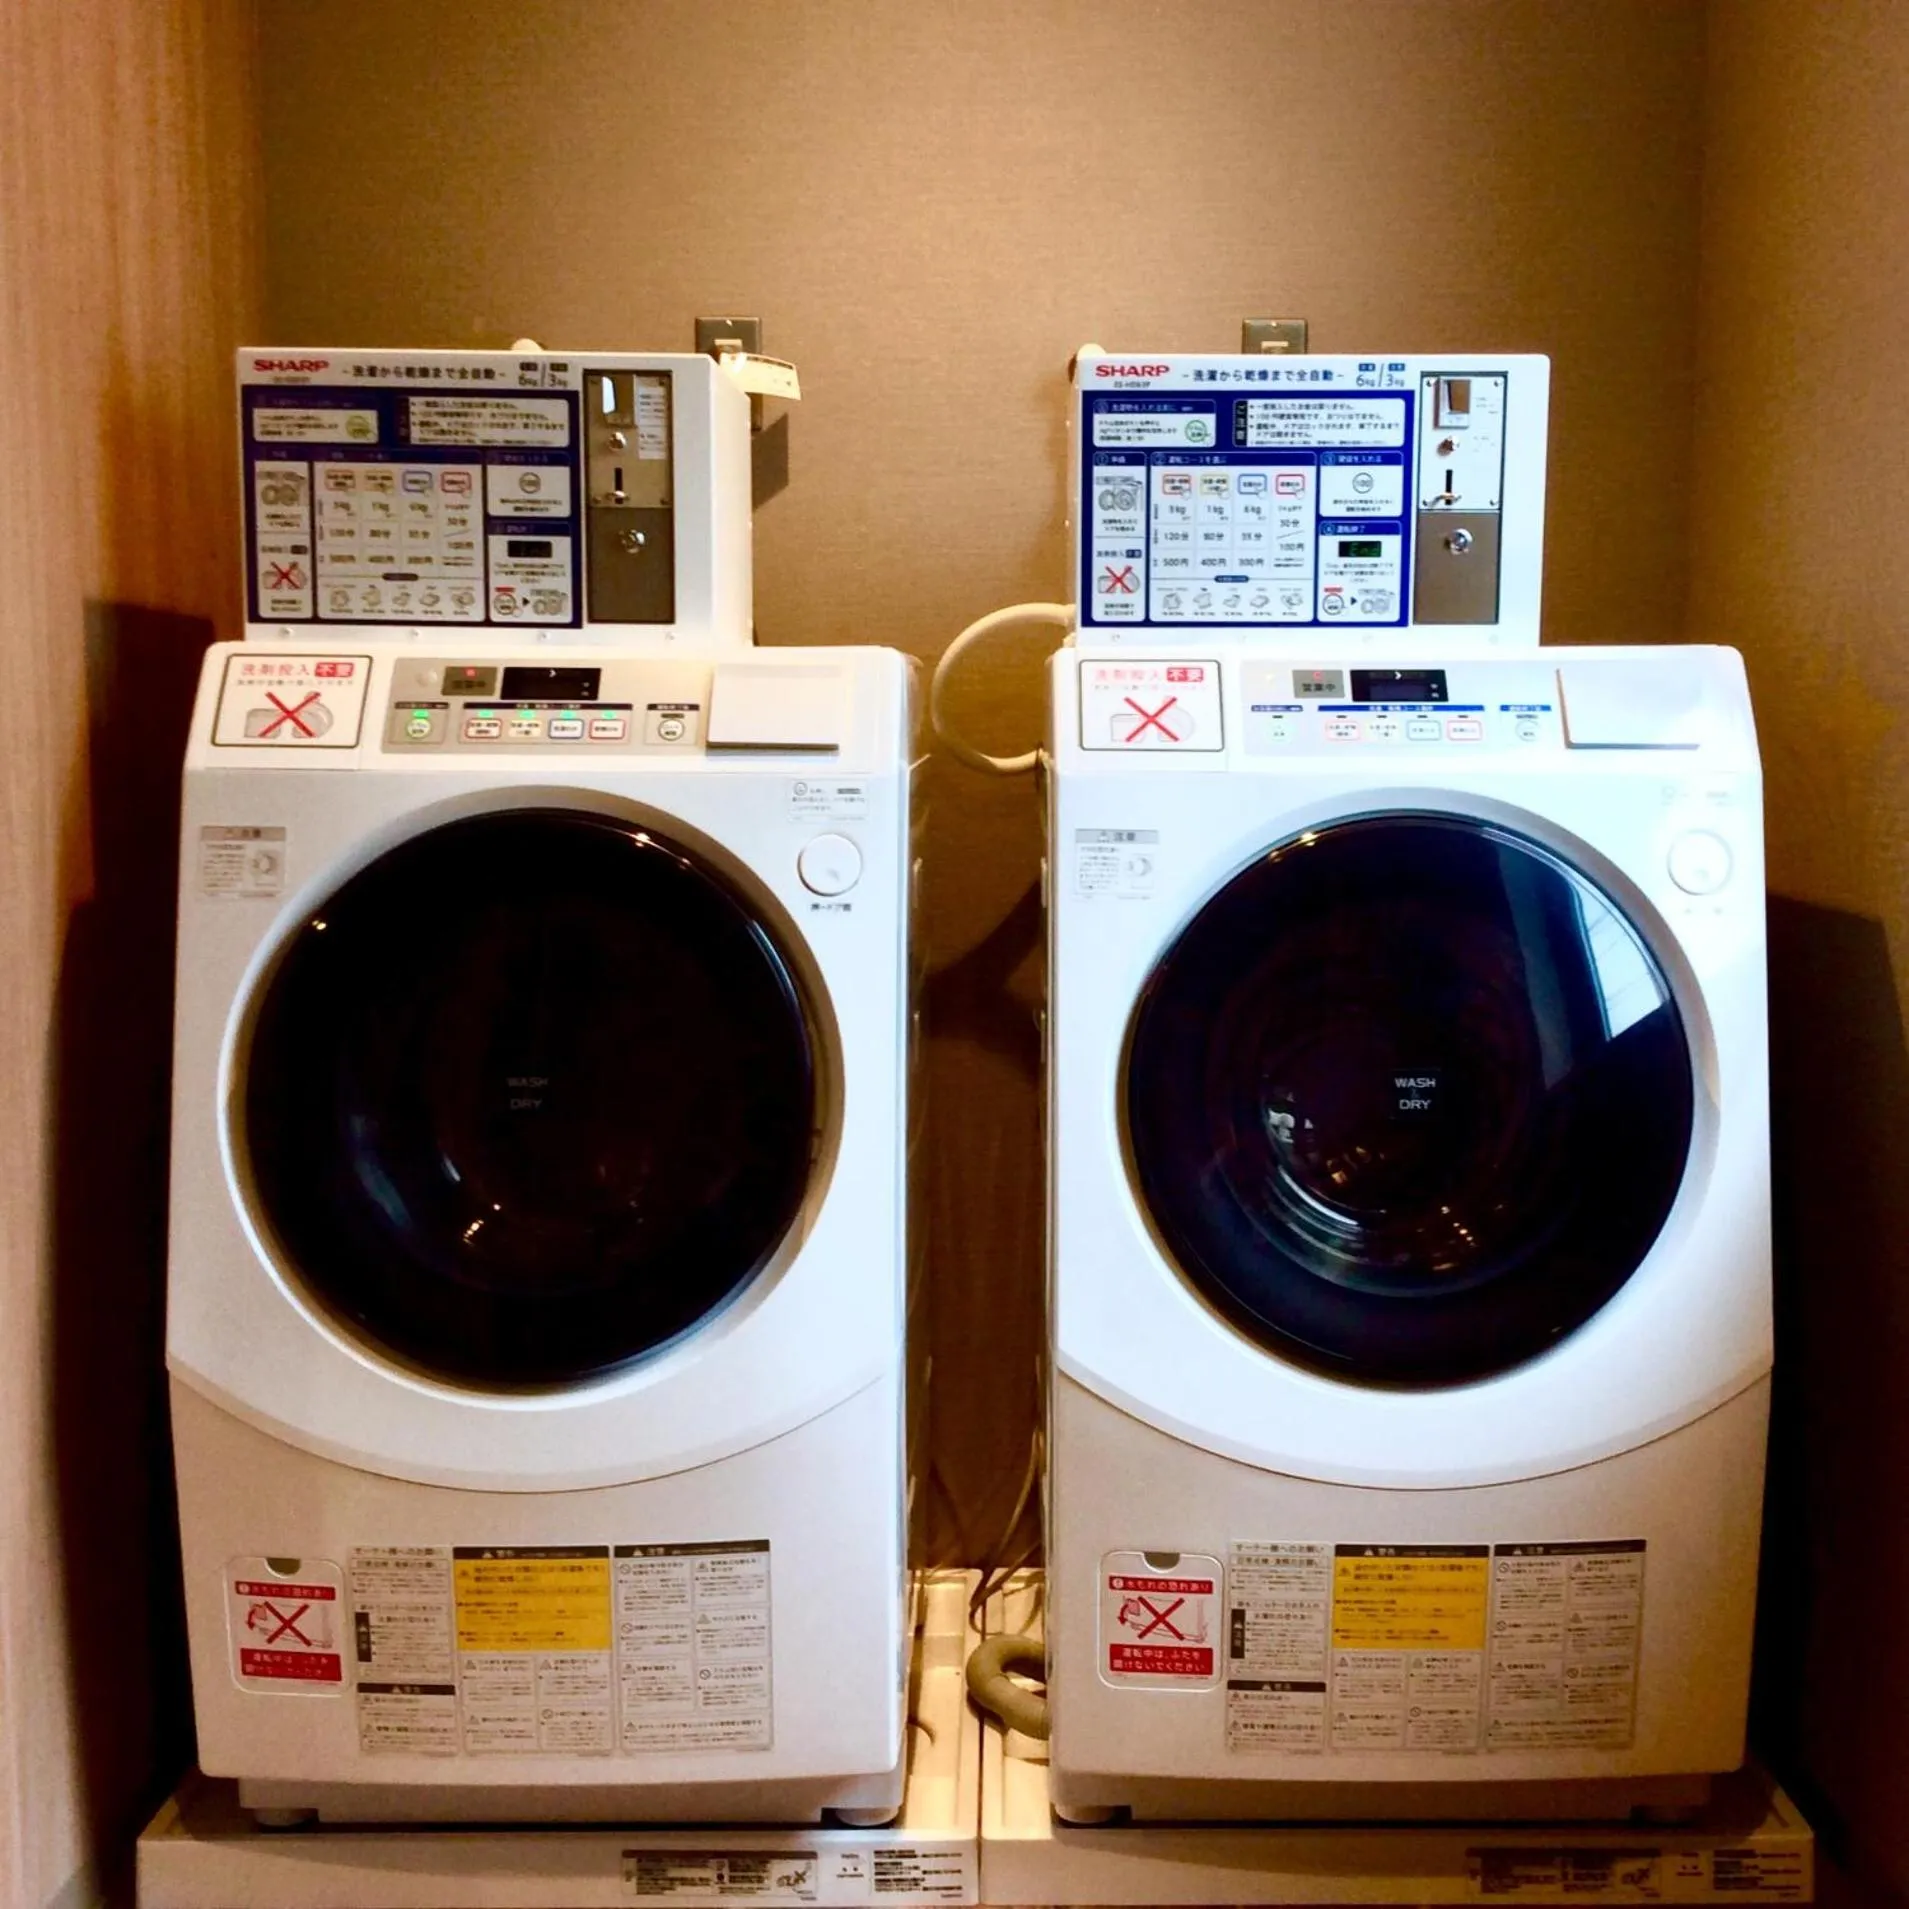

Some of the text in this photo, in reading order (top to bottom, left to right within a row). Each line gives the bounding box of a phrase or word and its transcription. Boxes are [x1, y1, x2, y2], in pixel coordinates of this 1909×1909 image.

[253, 360, 329, 372] SHARP
[1095, 364, 1170, 378] SHARP
[1394, 1078, 1437, 1088] WASH
[1399, 1099, 1431, 1110] DRY
